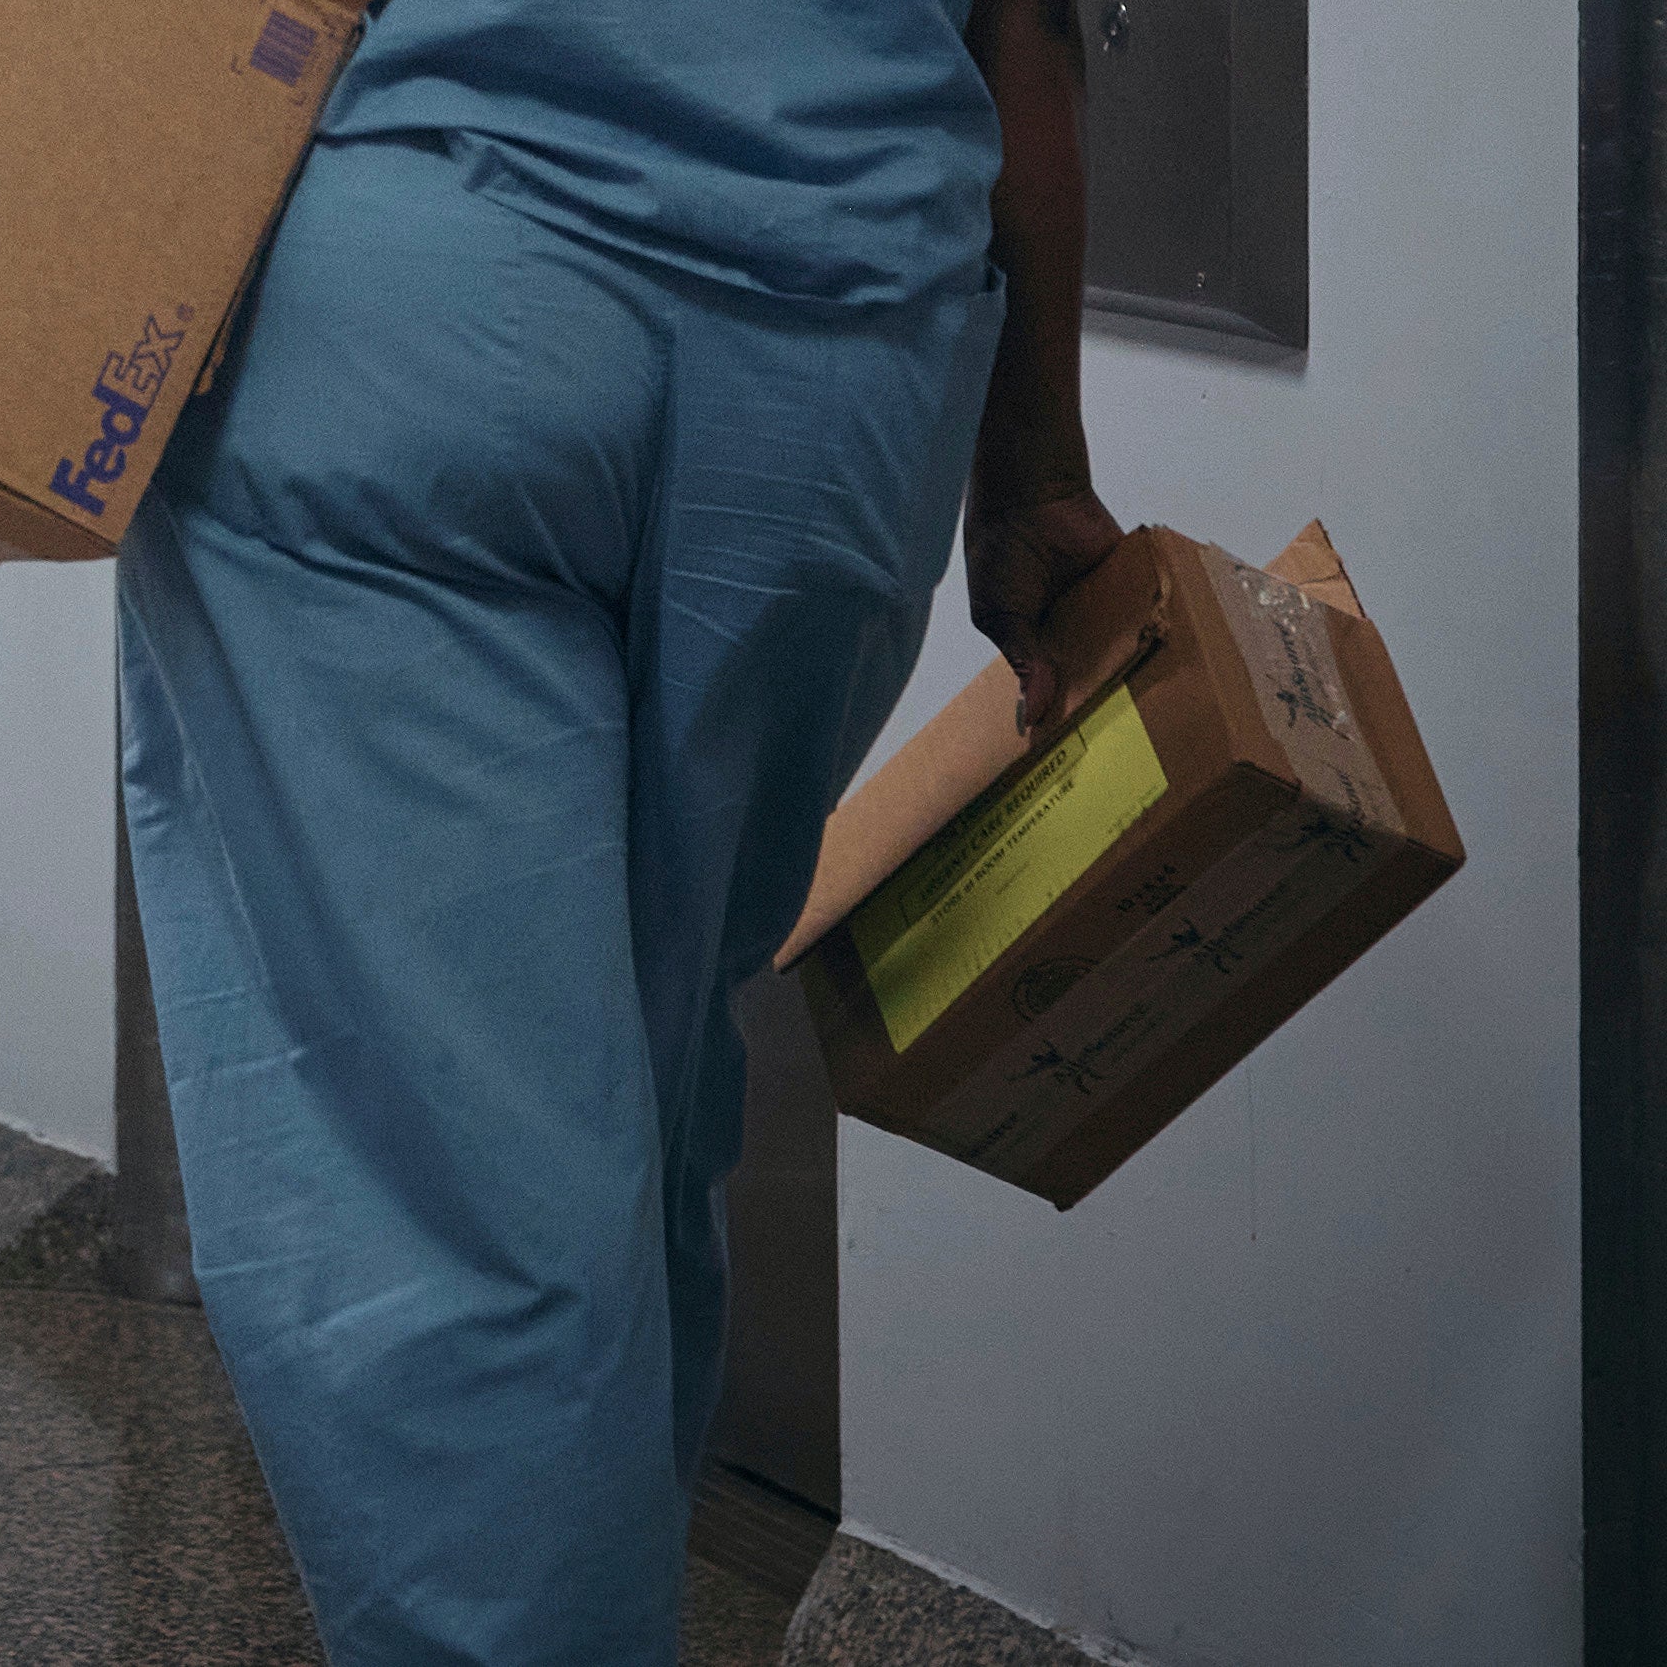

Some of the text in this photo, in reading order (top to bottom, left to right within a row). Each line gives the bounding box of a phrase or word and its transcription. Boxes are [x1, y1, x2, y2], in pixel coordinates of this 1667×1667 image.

[49, 312, 186, 517] FedEx
[969, 815, 1004, 852] CARE
[1005, 748, 1067, 817] REQUIRED
[974, 846, 1006, 881] ROOM
[1006, 778, 1075, 850] TEMPERATURE
